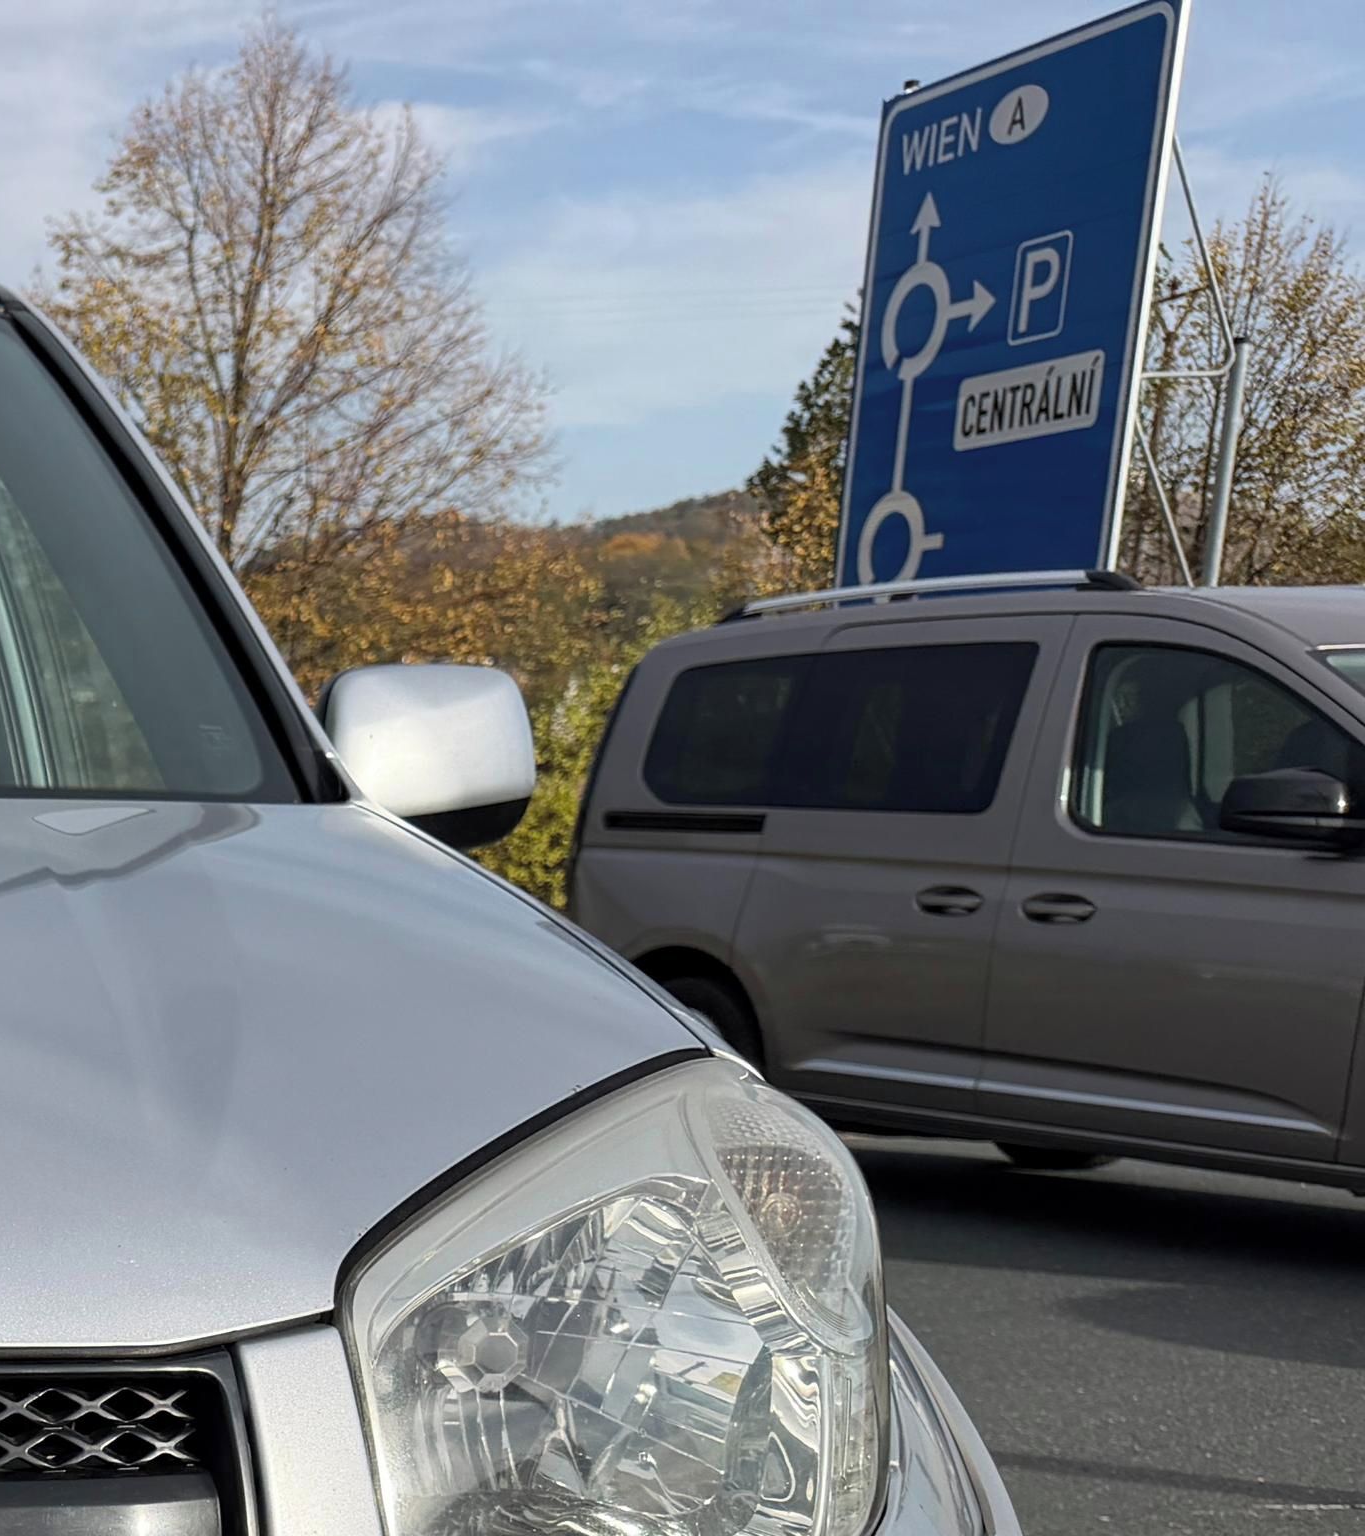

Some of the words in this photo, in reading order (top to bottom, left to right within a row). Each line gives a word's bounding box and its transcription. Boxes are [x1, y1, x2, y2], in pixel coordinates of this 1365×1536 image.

[902, 108, 983, 175] WIEN
[1007, 96, 1026, 136] A
[1017, 247, 1060, 334] P
[961, 356, 1101, 438] CENTRÁLNÍ
